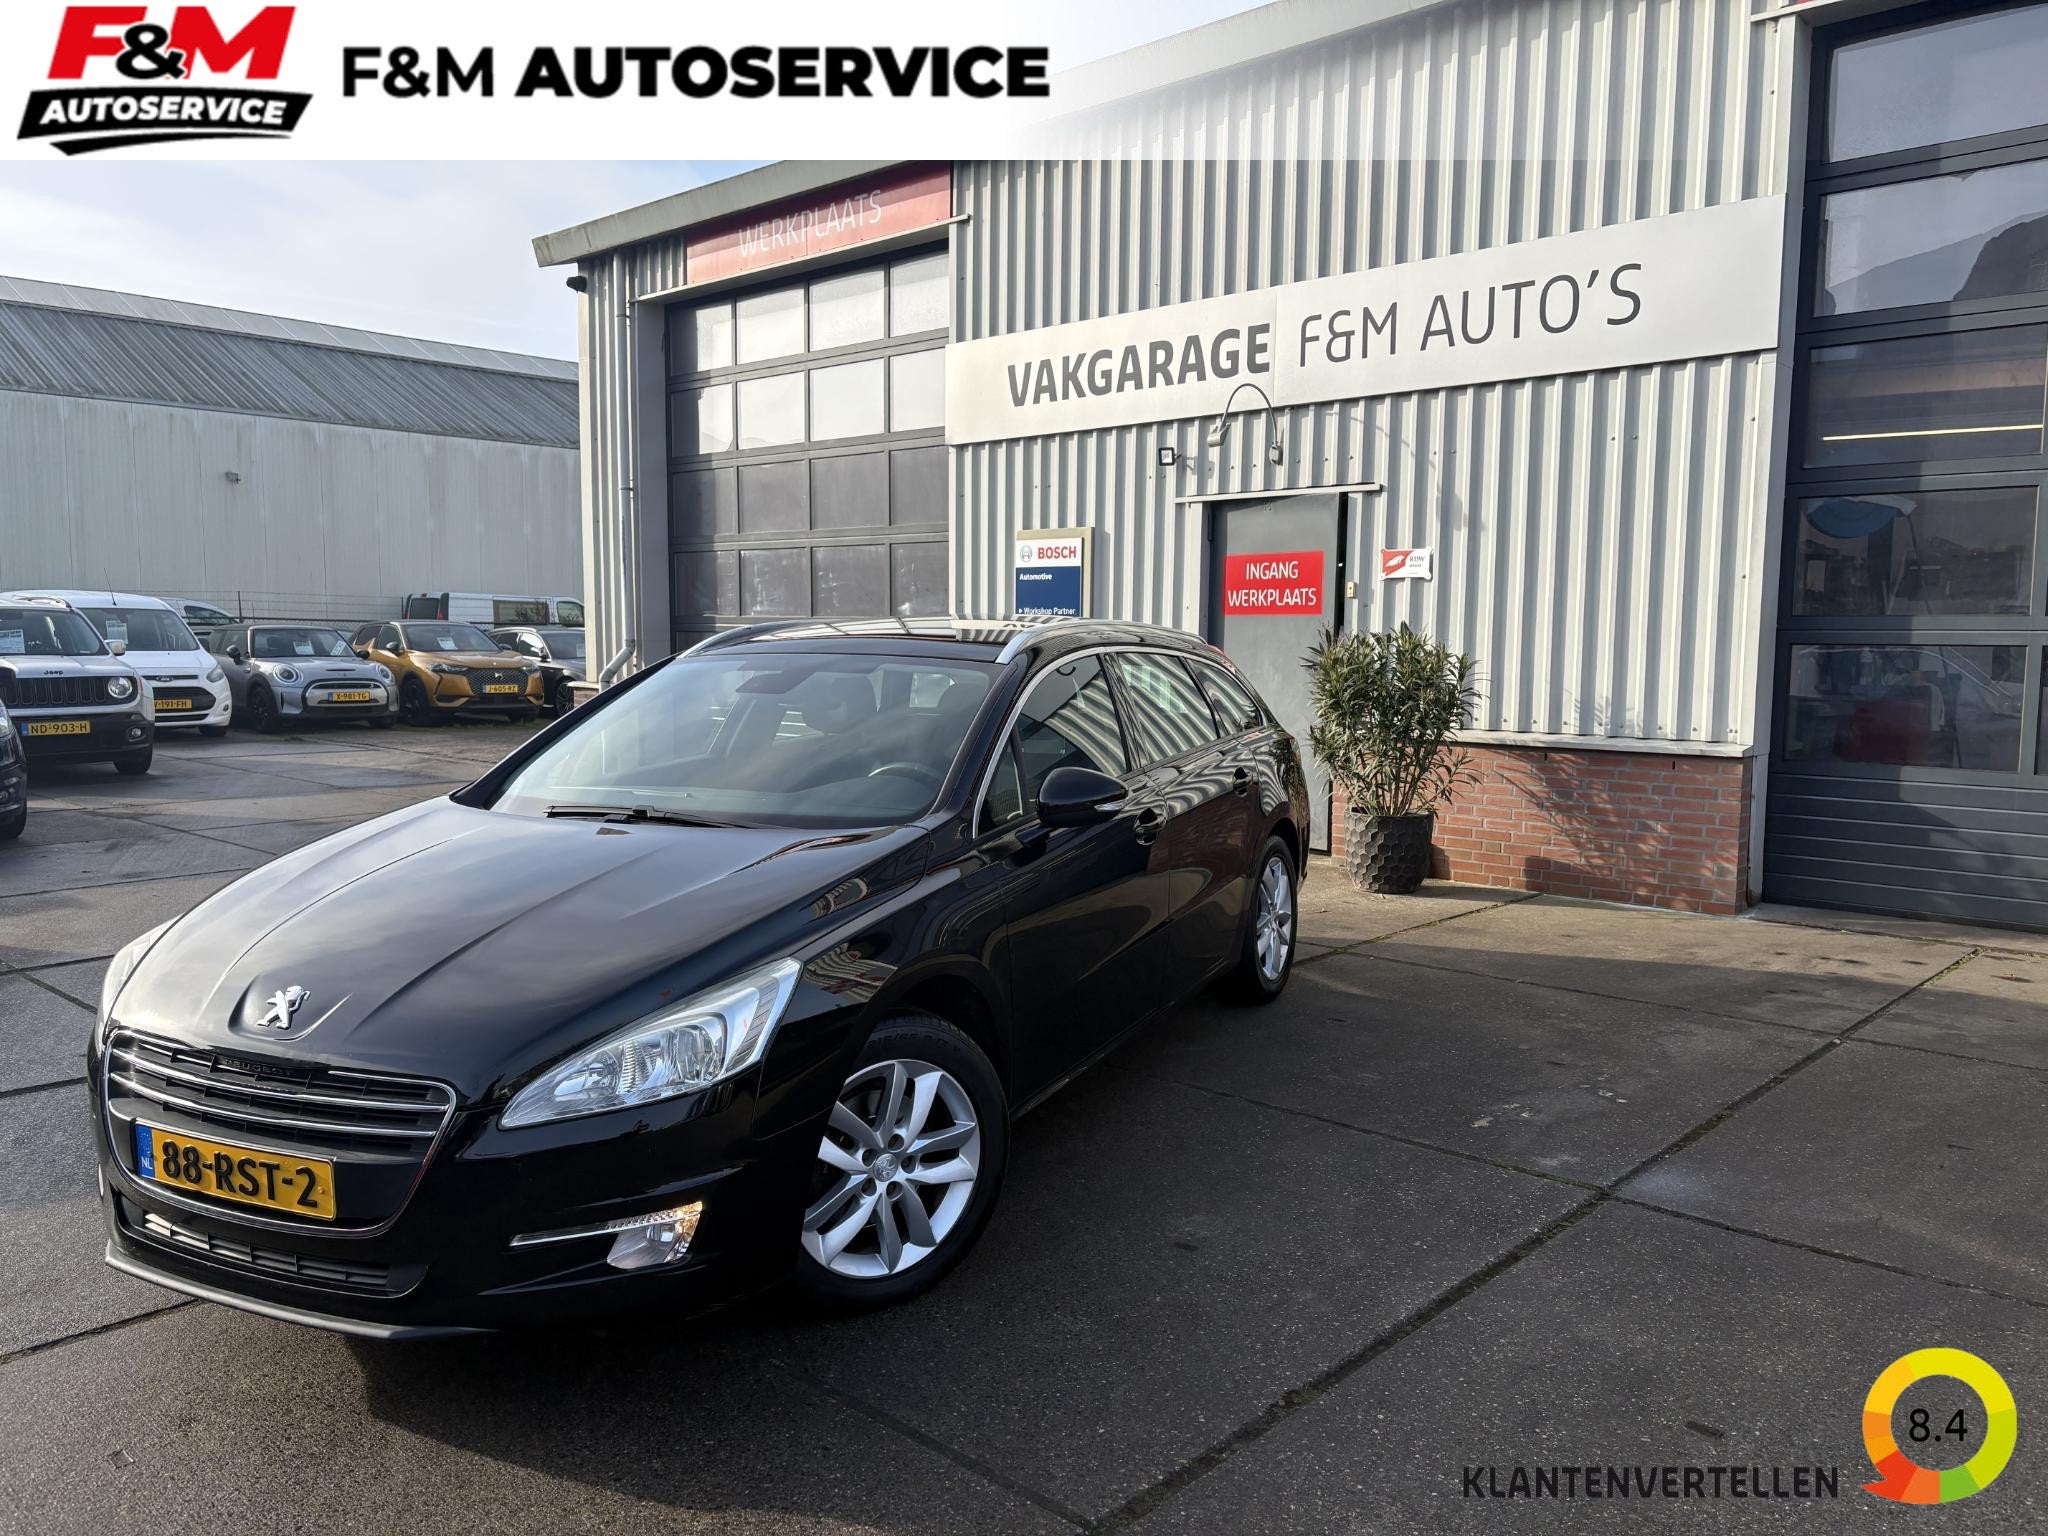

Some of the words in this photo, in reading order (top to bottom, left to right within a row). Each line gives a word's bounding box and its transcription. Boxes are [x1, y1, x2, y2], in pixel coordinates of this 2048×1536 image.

[738, 189, 882, 257] WERKPLAATS
[1007, 322, 1271, 408] VAKGARAGE
[1299, 302, 1398, 368] F&M
[1420, 263, 1642, 351] AUTO'S
[1037, 545, 1077, 559] BOSCH
[1019, 573, 1053, 581] Automotive
[1245, 560, 1299, 580] INGANG
[1227, 587, 1318, 607] WERKPLAATS
[1023, 606, 1053, 615] Workshop
[1053, 606, 1077, 616] Partner
[30, 722, 88, 734] ND-903-H
[140, 1155, 153, 1170] NL
[161, 1138, 318, 1209] 88-RST-2
